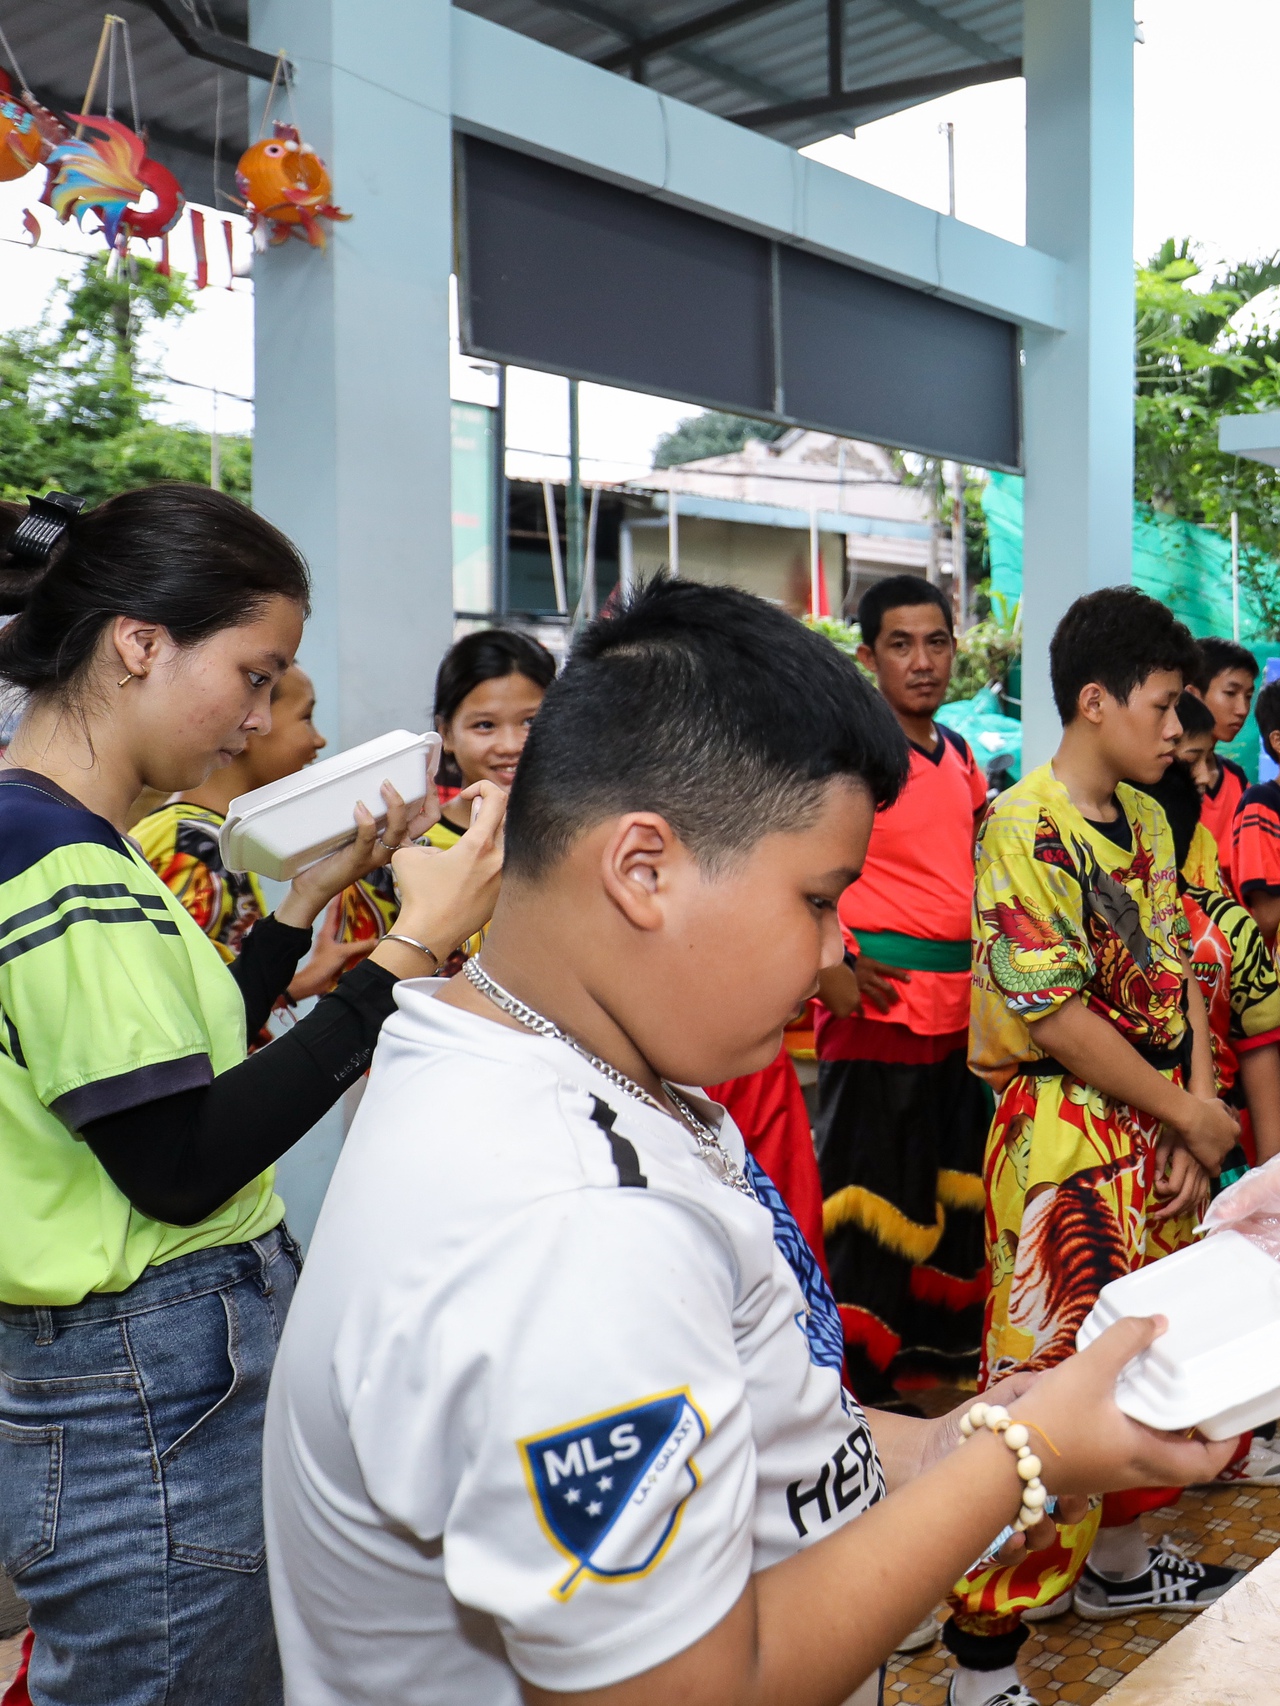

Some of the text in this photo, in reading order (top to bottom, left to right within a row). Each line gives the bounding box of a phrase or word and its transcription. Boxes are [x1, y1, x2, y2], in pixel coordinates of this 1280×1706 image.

[542, 1422, 642, 1487] MLS
[632, 1418, 693, 1505] LA GALAXY
